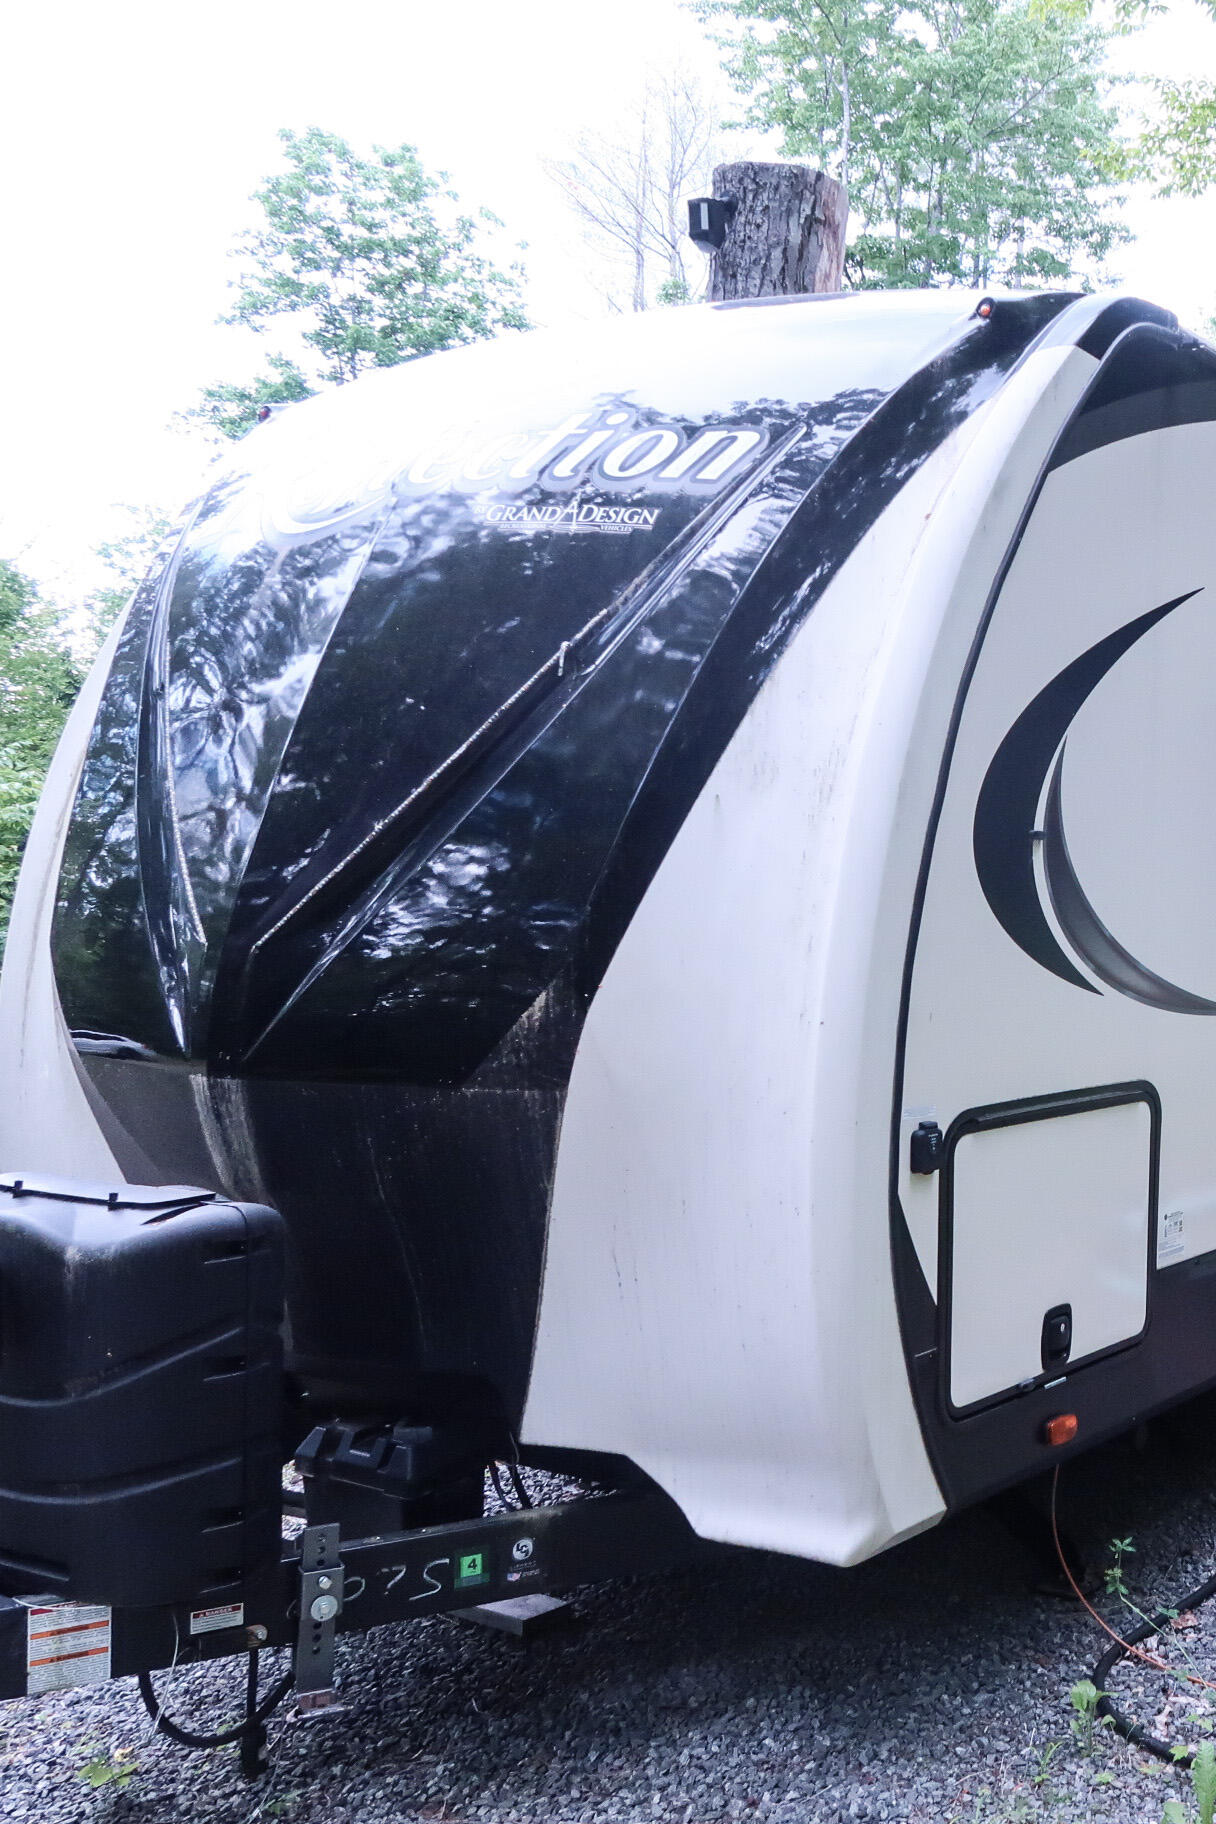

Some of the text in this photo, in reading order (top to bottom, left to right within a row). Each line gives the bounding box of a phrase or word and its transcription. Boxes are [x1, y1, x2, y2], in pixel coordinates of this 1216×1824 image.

[486, 504, 561, 522] GRAND
[578, 504, 662, 524] DESIGN
[467, 1557, 478, 1570] 4
